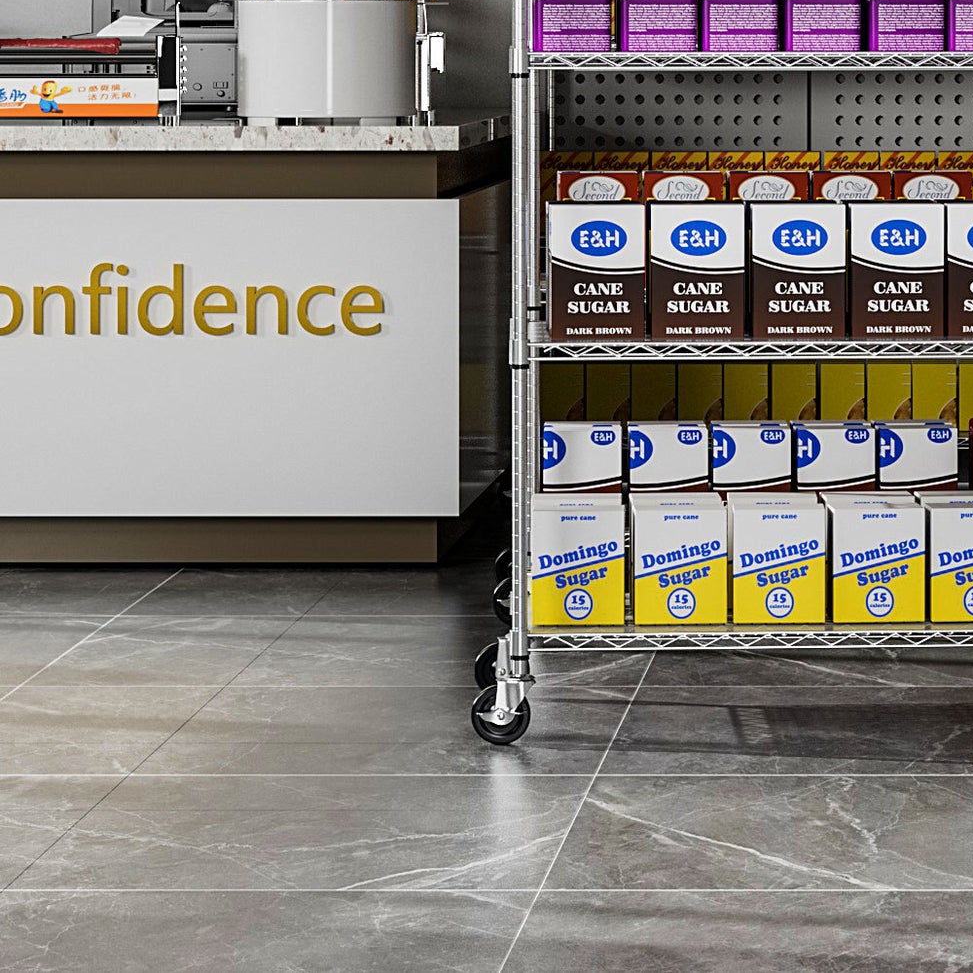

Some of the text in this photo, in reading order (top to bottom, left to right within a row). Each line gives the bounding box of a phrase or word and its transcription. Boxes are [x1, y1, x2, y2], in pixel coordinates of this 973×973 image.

[579, 230, 620, 248] E&H
[679, 230, 720, 247] E&H
[780, 229, 821, 247] E&H
[879, 229, 920, 247] E&H
[574, 283, 623, 295] CANE
[673, 283, 722, 295] CANE
[775, 282, 824, 294] CANE
[873, 282, 923, 294] CANE
[568, 301, 630, 313] SUGAR
[667, 301, 730, 313] SUGAR
[769, 300, 831, 312] SUGAR
[868, 300, 930, 312] SUGAR
[595, 432, 613, 441] E&H
[681, 432, 700, 441] E&H
[764, 432, 782, 440] E&H
[849, 431, 867, 440] E&H
[931, 430, 949, 439] E&H
[539, 540, 618, 570] Domingo
[642, 539, 721, 569] Domingo
[741, 539, 819, 568] Domingo
[841, 538, 919, 568] Domingo
[555, 567, 608, 589] Sugar
[658, 565, 711, 588] Sugar
[757, 564, 809, 587] Sugar
[857, 563, 909, 587] Sugar
[571, 595, 585, 605] 15
[674, 594, 689, 604] 15
[772, 594, 787, 604] 15
[872, 593, 887, 602] 15
